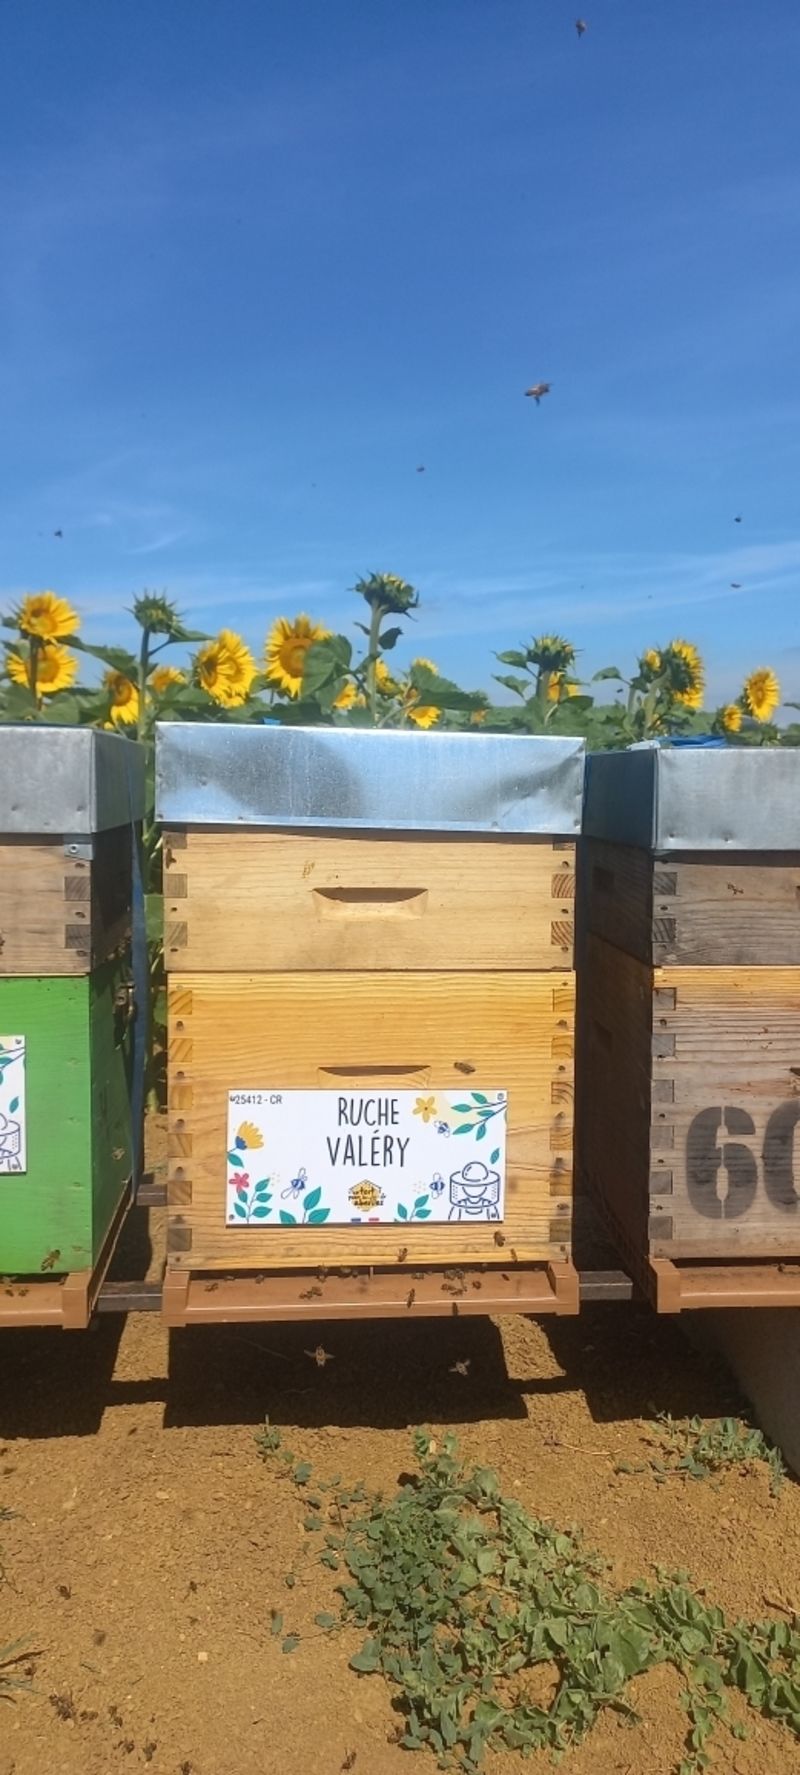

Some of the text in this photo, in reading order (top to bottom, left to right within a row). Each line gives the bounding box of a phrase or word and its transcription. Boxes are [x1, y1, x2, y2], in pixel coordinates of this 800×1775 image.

[234, 1094, 262, 1104] 25412
[270, 1094, 283, 1104] CR
[337, 1096, 400, 1127] RUCHE
[326, 1130, 411, 1168] VALÉRY
